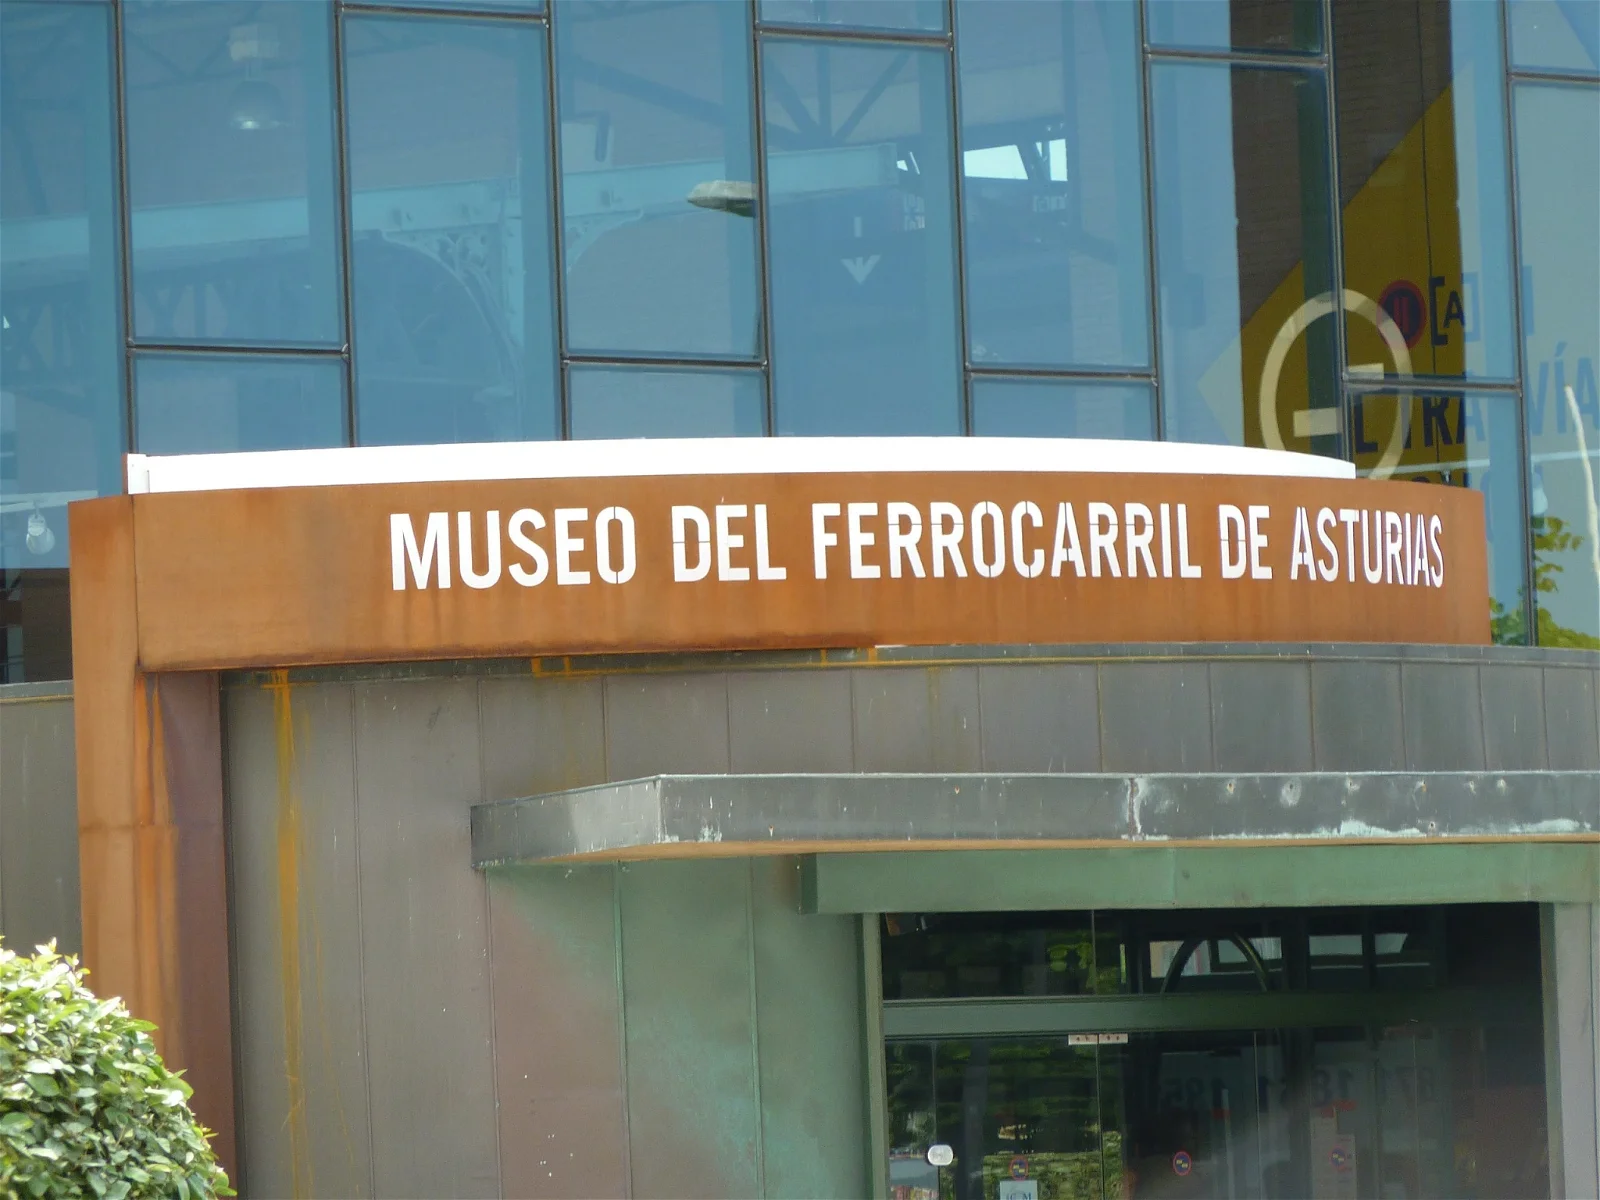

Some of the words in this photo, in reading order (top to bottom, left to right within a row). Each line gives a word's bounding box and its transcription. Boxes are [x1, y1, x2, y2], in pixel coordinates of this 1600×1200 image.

[389, 506, 637, 591] MUSEO
[671, 503, 788, 583] DEL
[811, 500, 1203, 580] FERROCARRIL
[1218, 503, 1273, 580] DE
[1290, 506, 1445, 588] ASTURIAS
